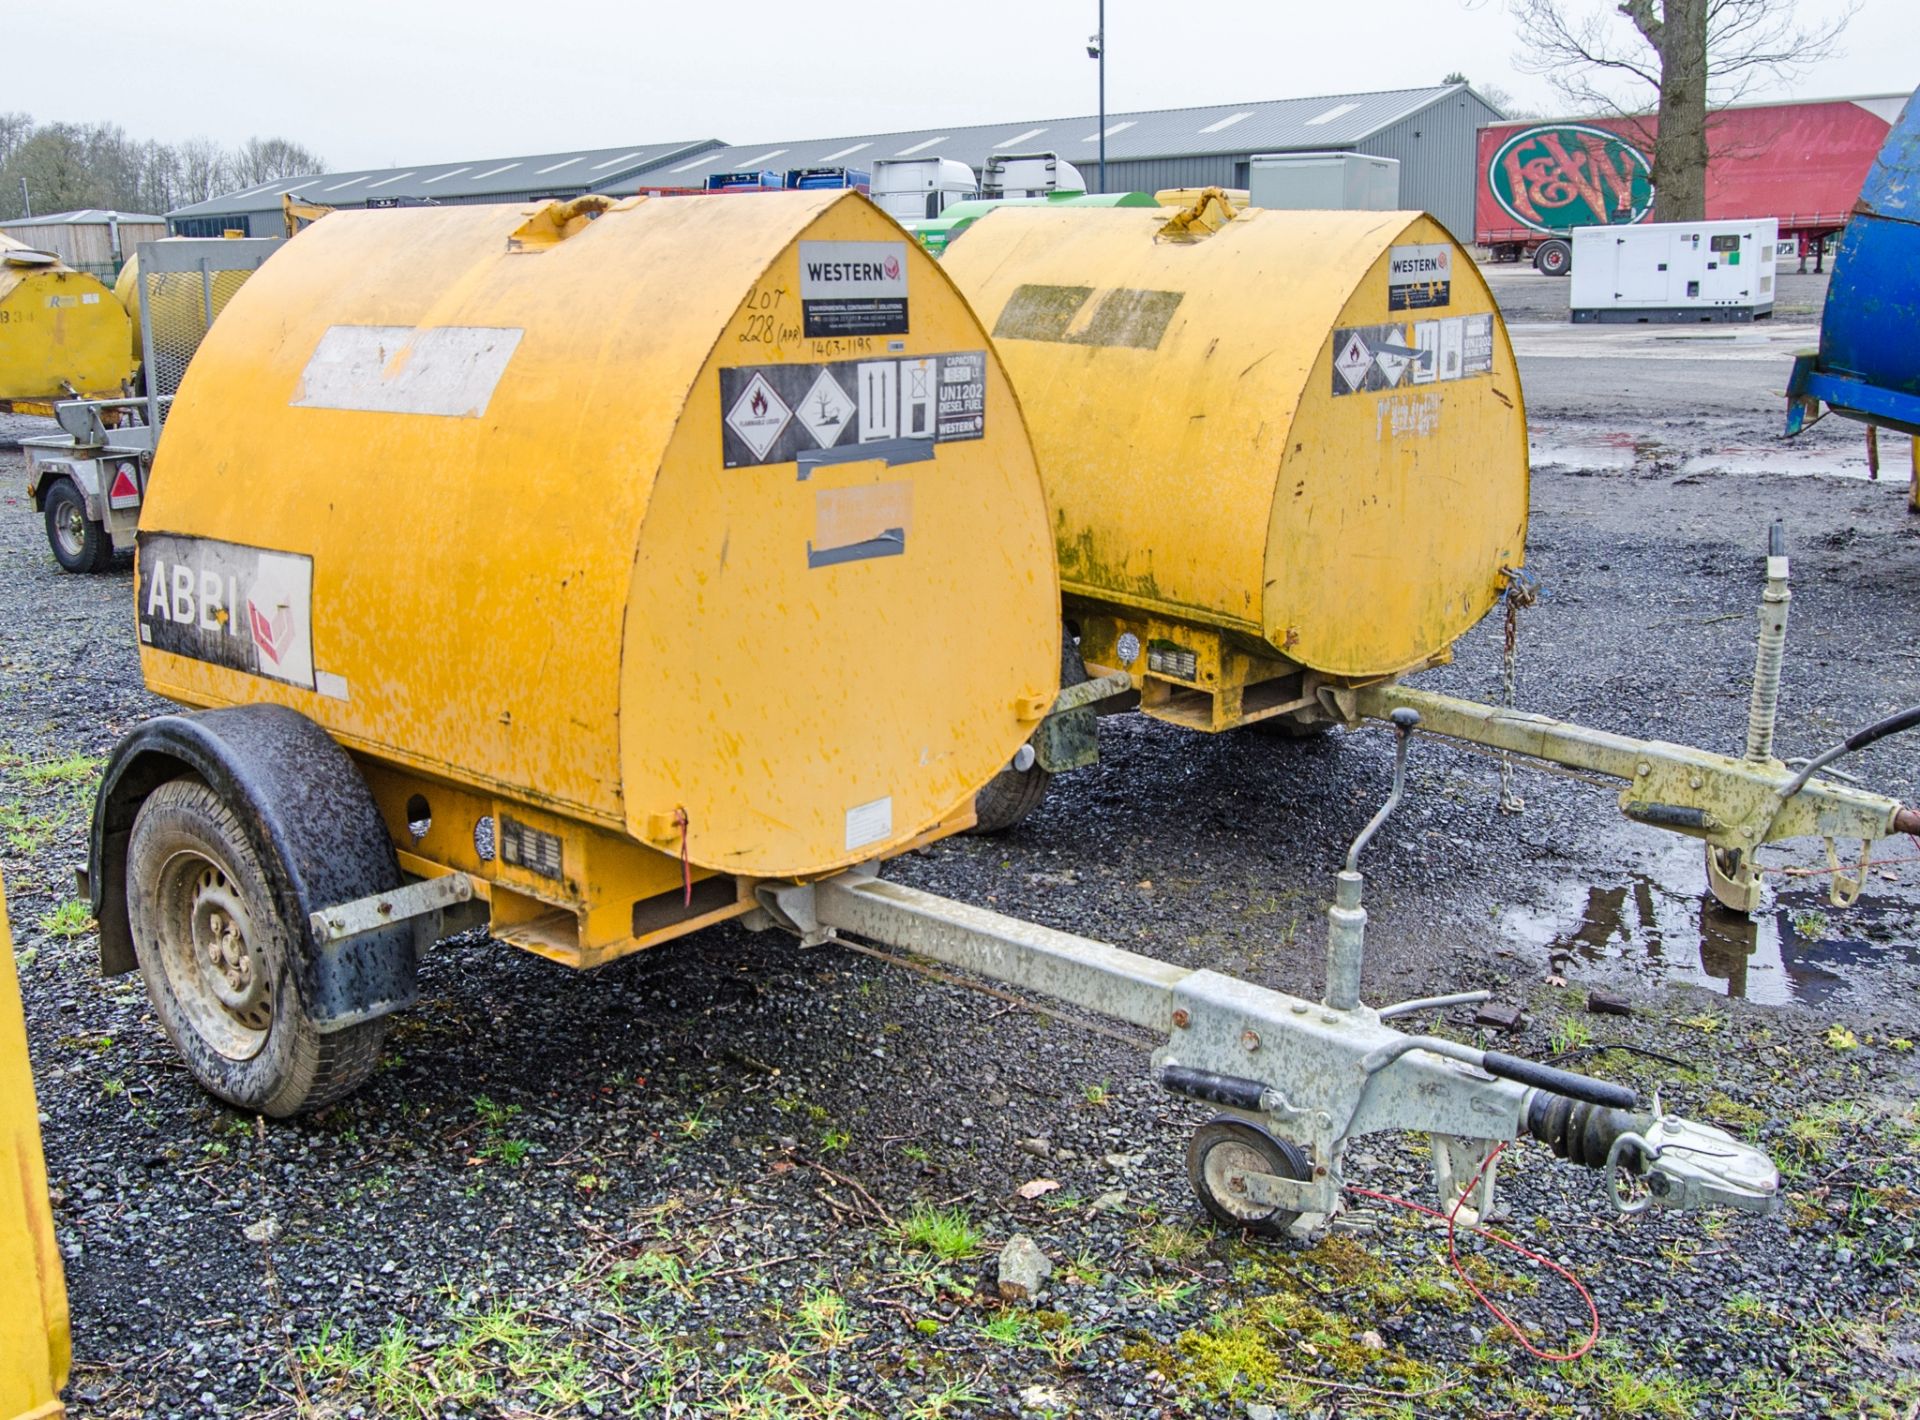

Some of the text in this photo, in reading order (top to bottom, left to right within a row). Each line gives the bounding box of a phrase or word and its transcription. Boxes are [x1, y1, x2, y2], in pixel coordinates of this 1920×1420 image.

[807, 262, 883, 281] WESTERN
[1393, 257, 1437, 273] WESTERN
[746, 288, 785, 310] LOT
[739, 315, 774, 344] 228
[940, 383, 983, 401] UN1202
[939, 398, 983, 412] DIESEL FUEL
[147, 559, 239, 637] ABBI
